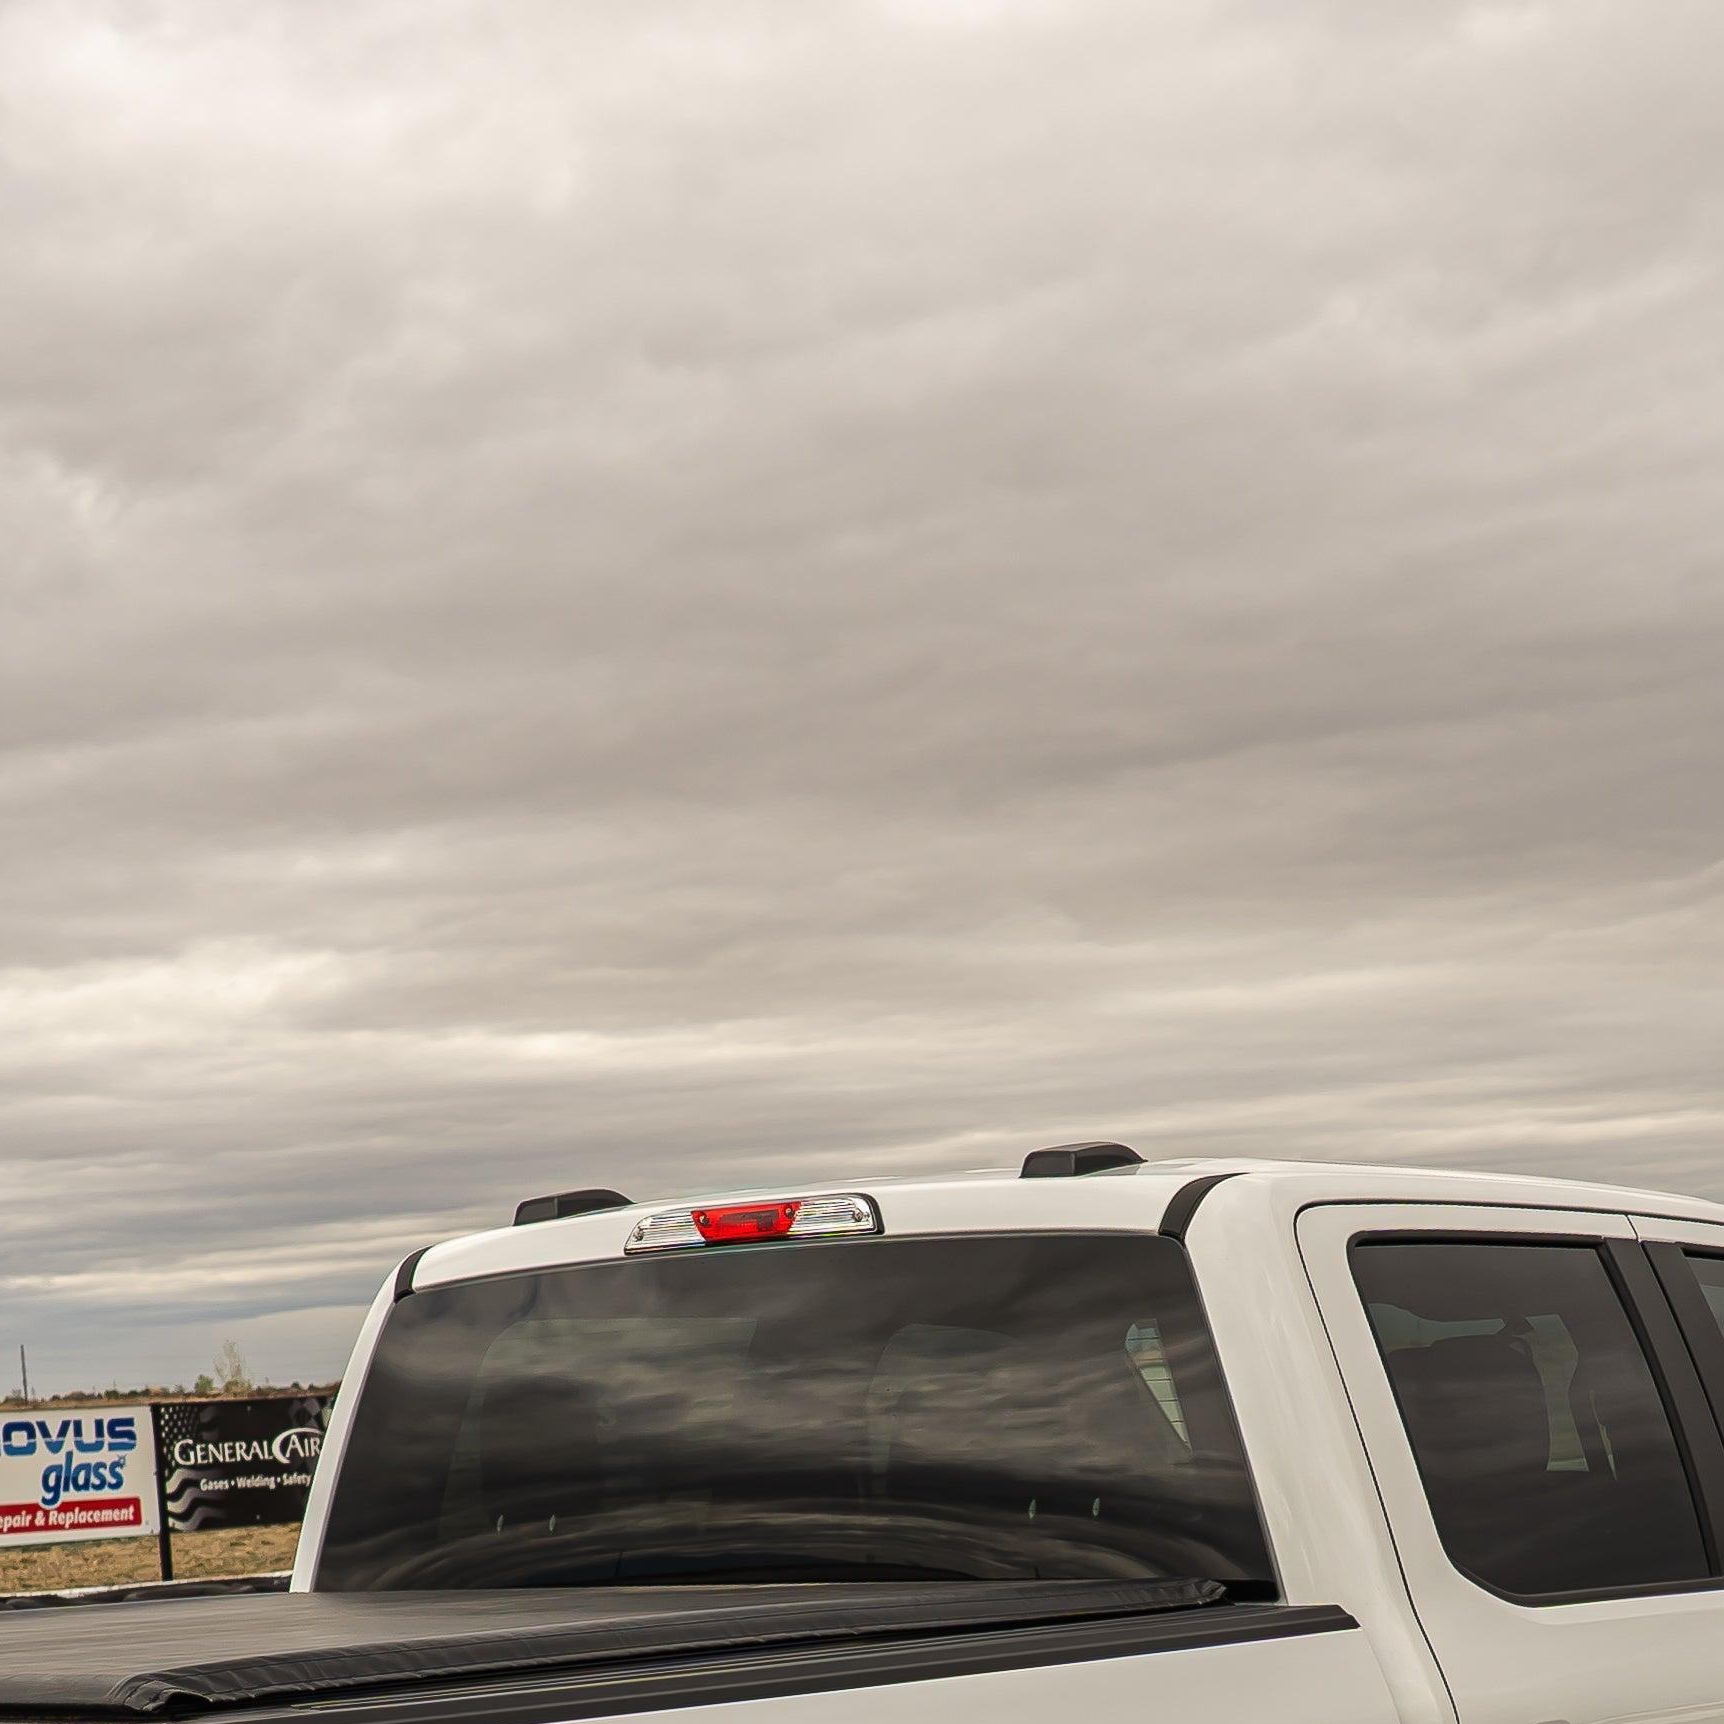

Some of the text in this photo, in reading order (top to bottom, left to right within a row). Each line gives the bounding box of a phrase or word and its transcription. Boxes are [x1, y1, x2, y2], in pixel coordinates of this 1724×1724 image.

[40, 1450, 126, 1506] glass
[199, 1472, 312, 1492] Gases Welding Safety
[34, 1511, 46, 1527] &
[48, 1504, 135, 1530] Replacement
